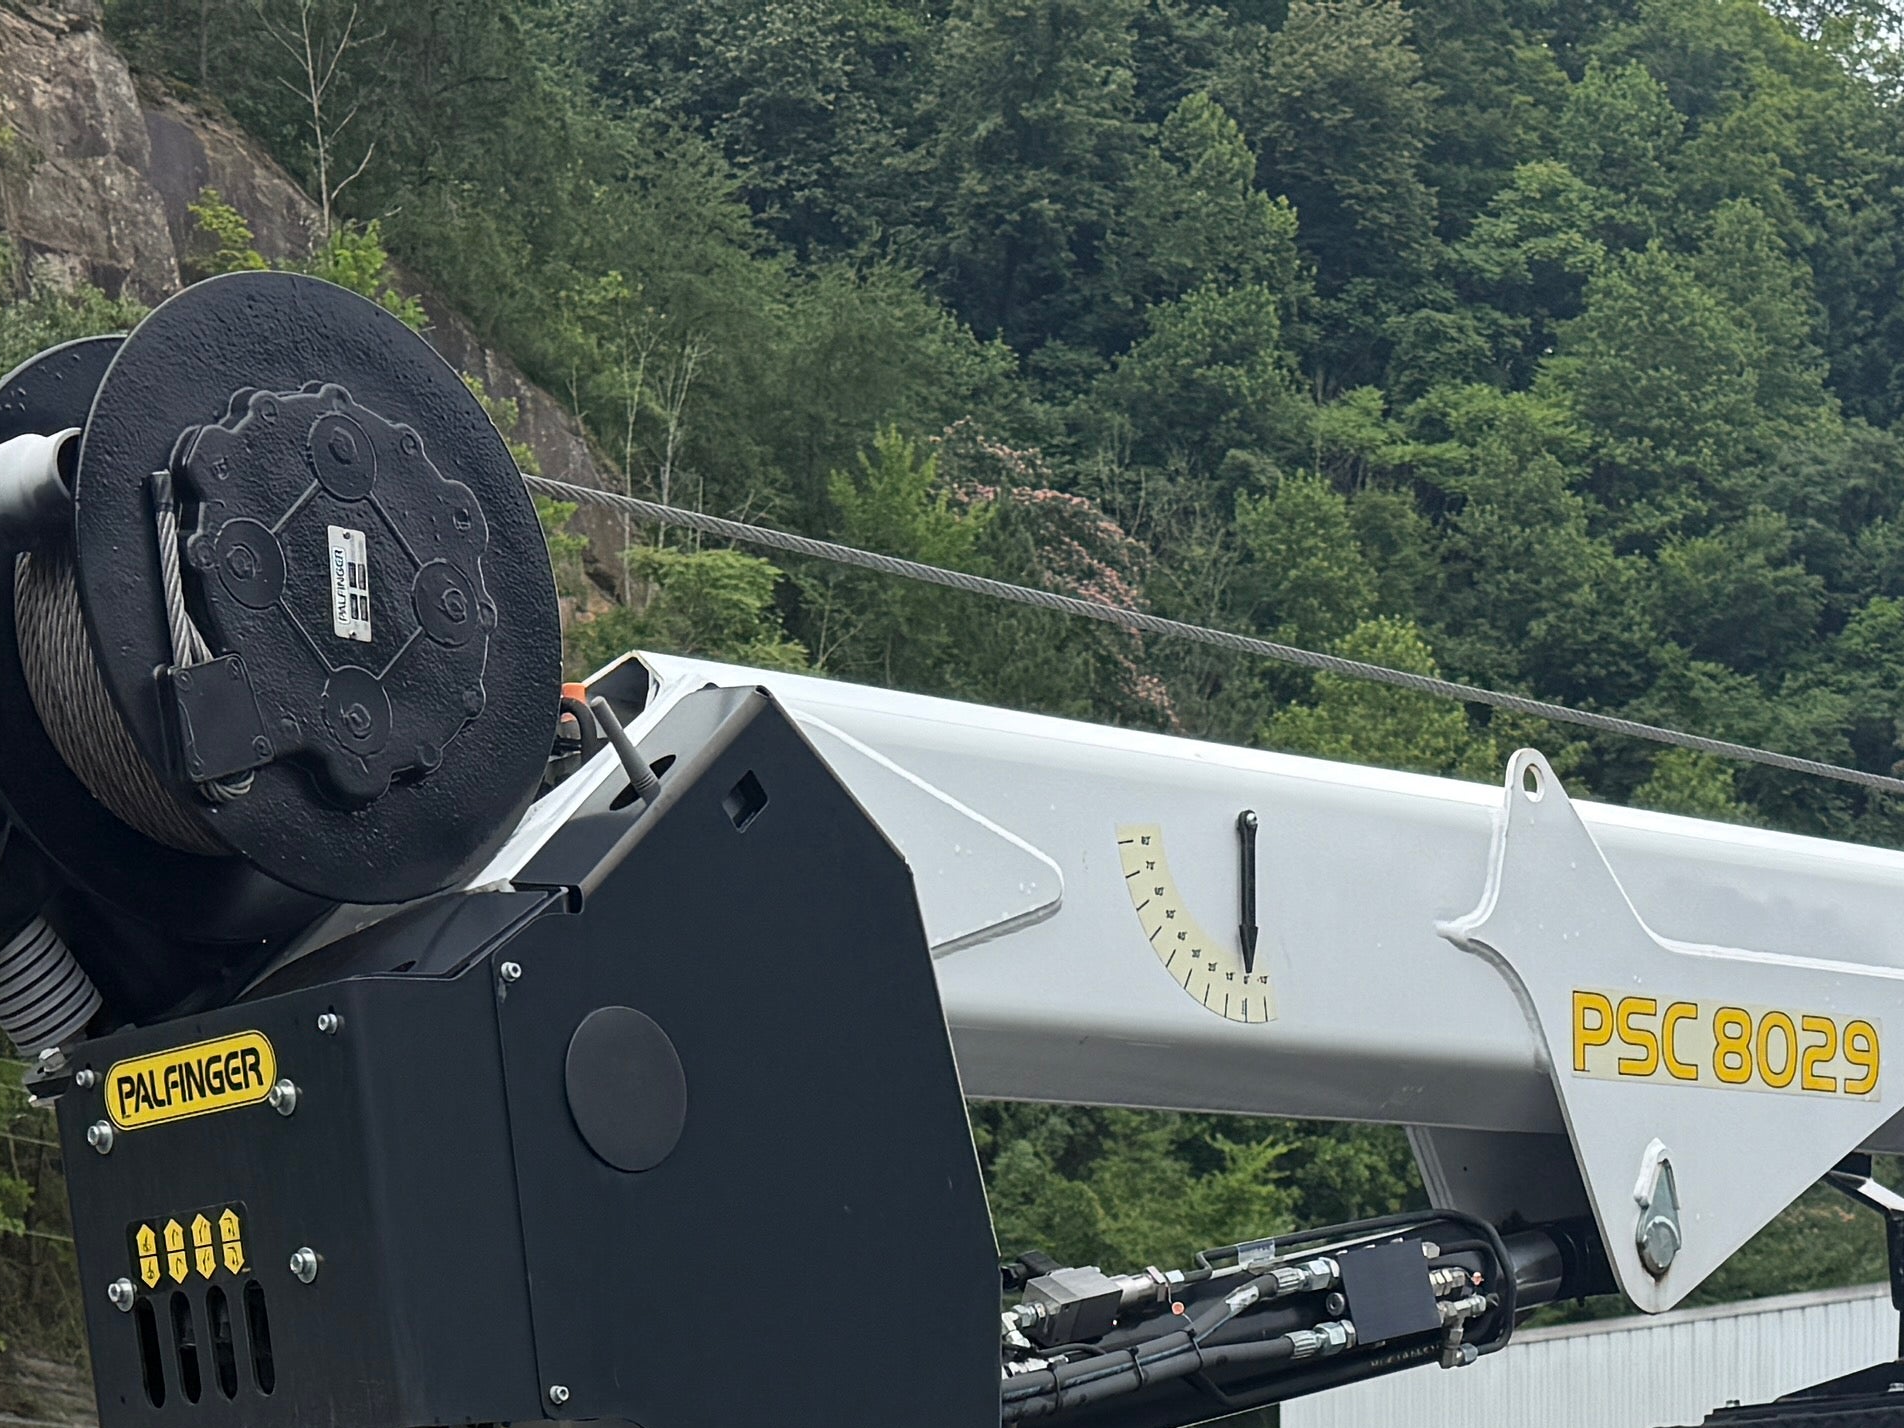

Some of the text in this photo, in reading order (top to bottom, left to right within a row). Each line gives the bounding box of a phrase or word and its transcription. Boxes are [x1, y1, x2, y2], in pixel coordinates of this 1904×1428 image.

[333, 549, 348, 622] PALFINGER
[1572, 990, 1880, 1095] PSC 8029
[117, 1047, 263, 1119] PALFINGER
